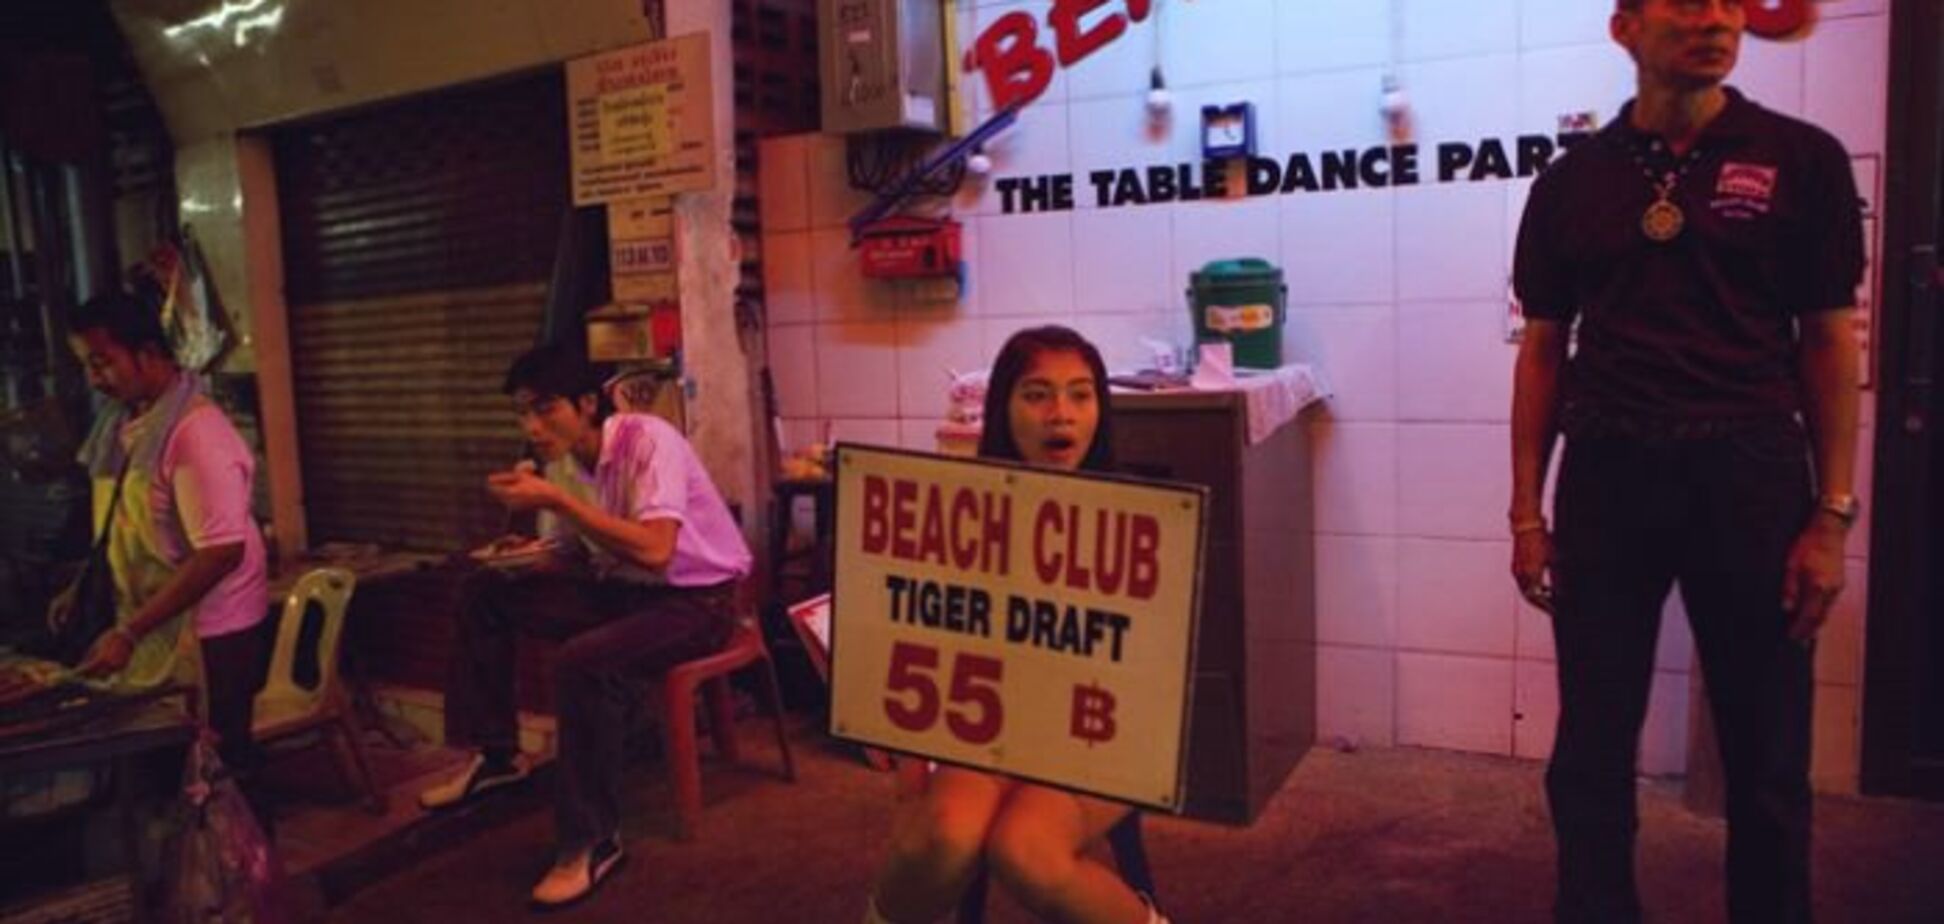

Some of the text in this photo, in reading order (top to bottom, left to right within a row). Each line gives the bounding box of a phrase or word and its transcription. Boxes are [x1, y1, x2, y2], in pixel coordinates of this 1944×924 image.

[963, 0, 1153, 111] BE
[997, 176, 1074, 213] THE
[1091, 162, 1227, 206] TABLE
[1247, 146, 1418, 195] DANCE
[862, 476, 1159, 600] BEACH CLUB
[887, 575, 1131, 661] TIGER DRAFT
[884, 642, 1004, 744] 55
